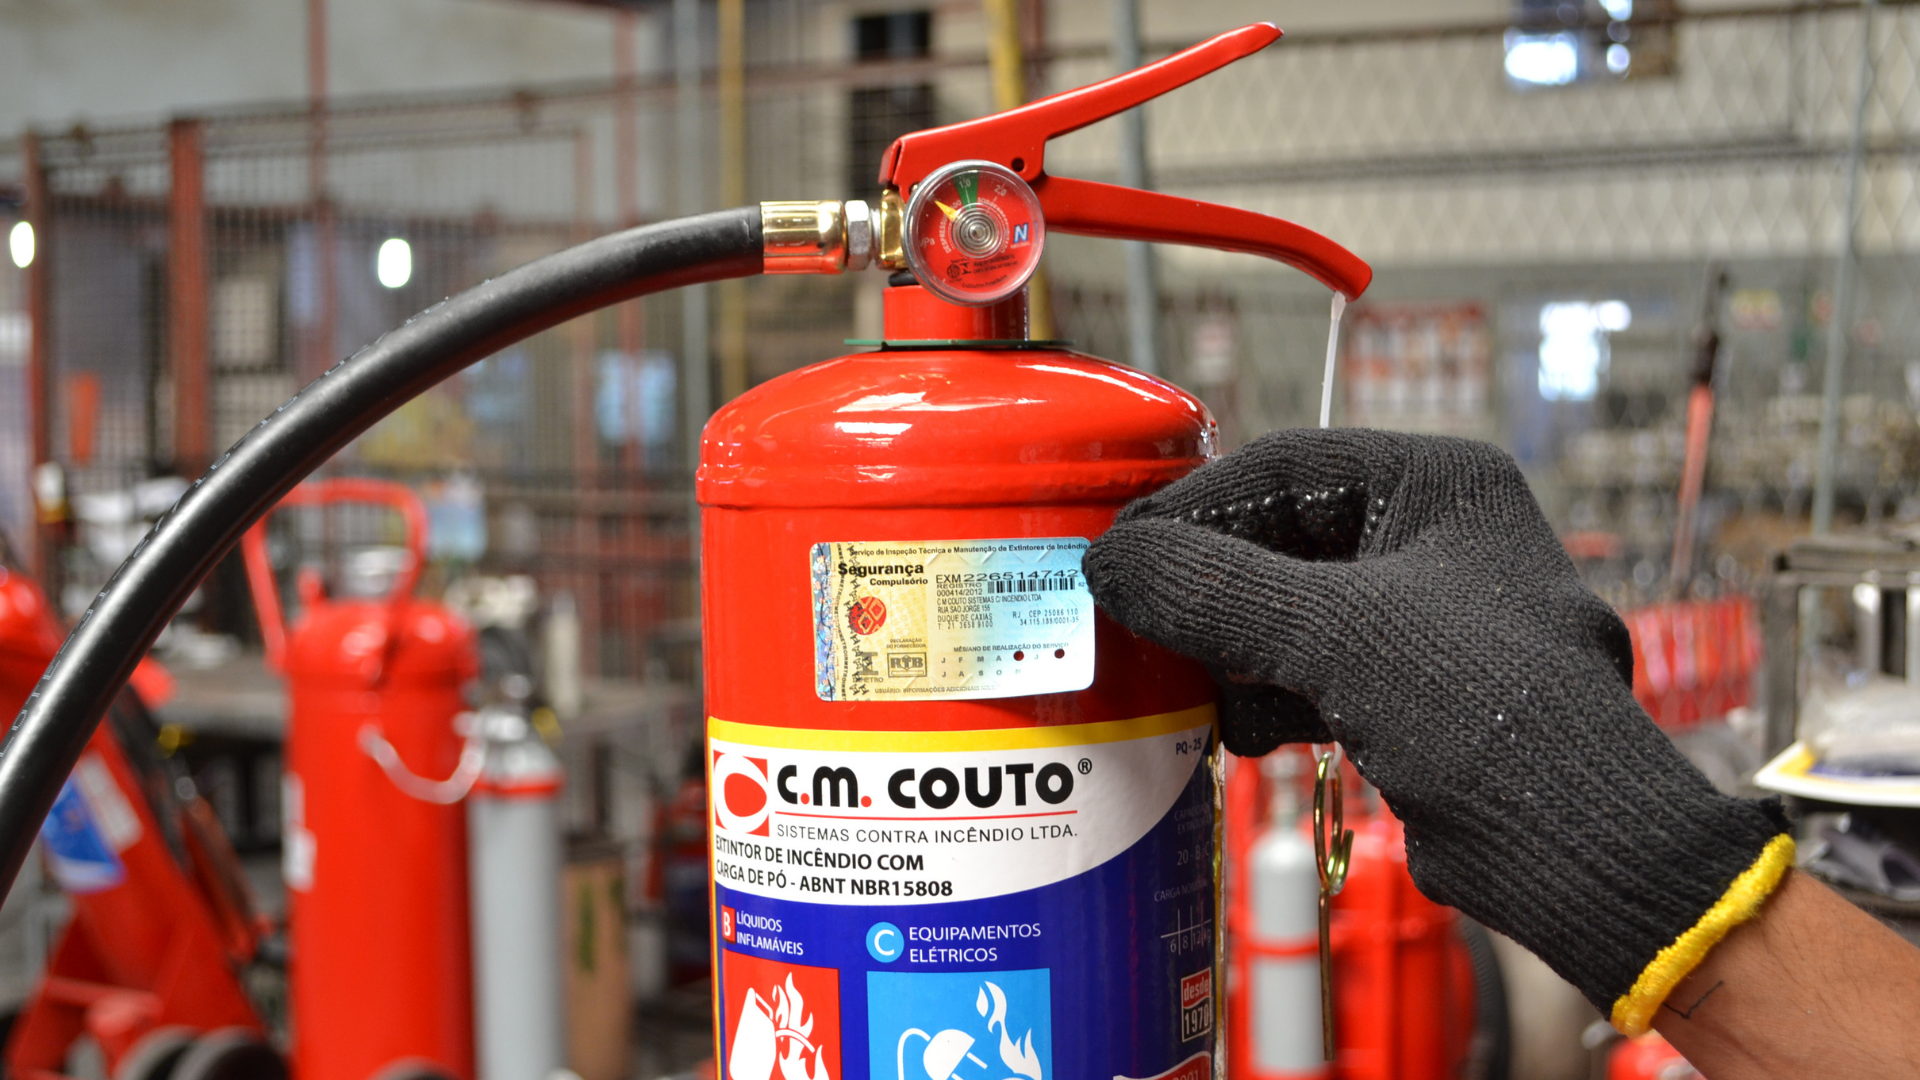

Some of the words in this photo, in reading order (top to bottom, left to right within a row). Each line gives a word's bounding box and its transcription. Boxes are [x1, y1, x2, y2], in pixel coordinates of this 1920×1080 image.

[876, 547, 885, 556] de
[886, 547, 918, 557] Inspeção
[919, 546, 946, 555] Técnica
[953, 545, 997, 555] Manutenção
[1008, 544, 1045, 552] Extintores
[1057, 542, 1088, 550] Incêndio
[838, 563, 924, 578] Segurança
[869, 577, 929, 587] Compulsório
[937, 588, 983, 596] 000414/2012
[948, 597, 967, 605] COUTO
[968, 595, 994, 604] SISTEMAS
[962, 604, 980, 613] JORGE
[1028, 610, 1041, 618] CEP
[937, 614, 959, 623] DUQUE
[961, 613, 969, 621] DE
[971, 612, 993, 621] CAXIAS
[992, 643, 1031, 651] REALIZAÇÃO
[887, 761, 1074, 810] COUTO
[777, 823, 850, 842] SISTEMAS
[856, 829, 929, 844] CONTRA
[935, 826, 1024, 844] INCÊNDIO
[1031, 823, 1078, 840] LTDA.
[715, 834, 762, 861] EXTINTOR
[765, 846, 783, 864] DE
[787, 847, 872, 870] INCÊNDIO
[877, 854, 924, 871] COM
[1177, 849, 1189, 866] 20
[716, 859, 745, 883] CARGA
[748, 867, 764, 886] DE
[767, 869, 787, 889] PÓ
[799, 875, 846, 894] ABNT
[851, 879, 953, 897] NBR15808
[1153, 886, 1181, 902] CARGA
[723, 911, 732, 937] B
[736, 910, 783, 933] LÍQUIDOS
[909, 923, 1042, 942] EQUIPAMENTOS
[736, 931, 804, 956] INFLAMÁVEIS
[874, 929, 895, 956] C
[909, 946, 998, 963] ELÉTRICOS
[1184, 1003, 1209, 1035] 1970
